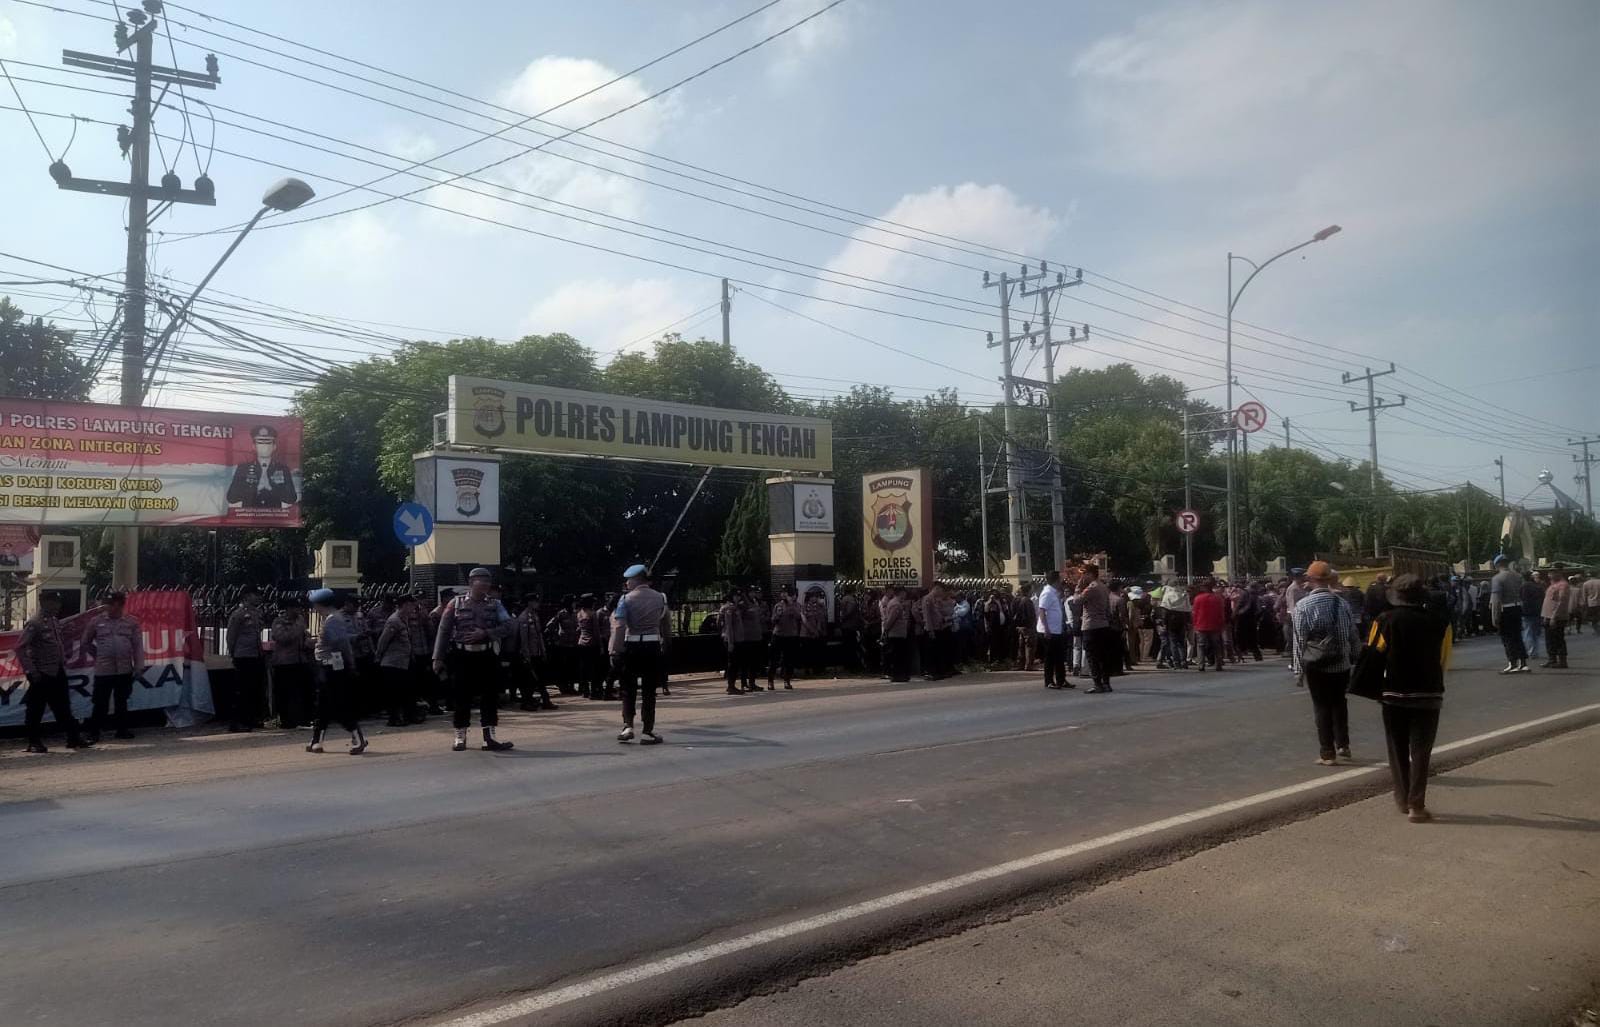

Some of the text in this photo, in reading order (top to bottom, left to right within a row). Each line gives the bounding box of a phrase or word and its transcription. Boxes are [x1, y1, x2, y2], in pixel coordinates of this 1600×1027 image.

[10, 413, 77, 431] POLRES
[83, 418, 166, 436] LAMPUNG
[171, 423, 233, 439] TENGAH
[516, 396, 816, 460] POLRES LAMPUNG TENGAH
[0, 435, 162, 455] AN ZONA INTEGRITAS
[17, 475, 53, 489] DARI
[56, 476, 116, 491] KORUPSI
[120, 476, 162, 493] (WBK)
[871, 479, 910, 491] LAMPUNG
[13, 494, 60, 509] BERSIH
[63, 496, 126, 511] MELAYANI
[129, 496, 179, 511] (WBBM)
[872, 557, 912, 569] POLRES
[867, 568, 918, 580] LAMTENG
